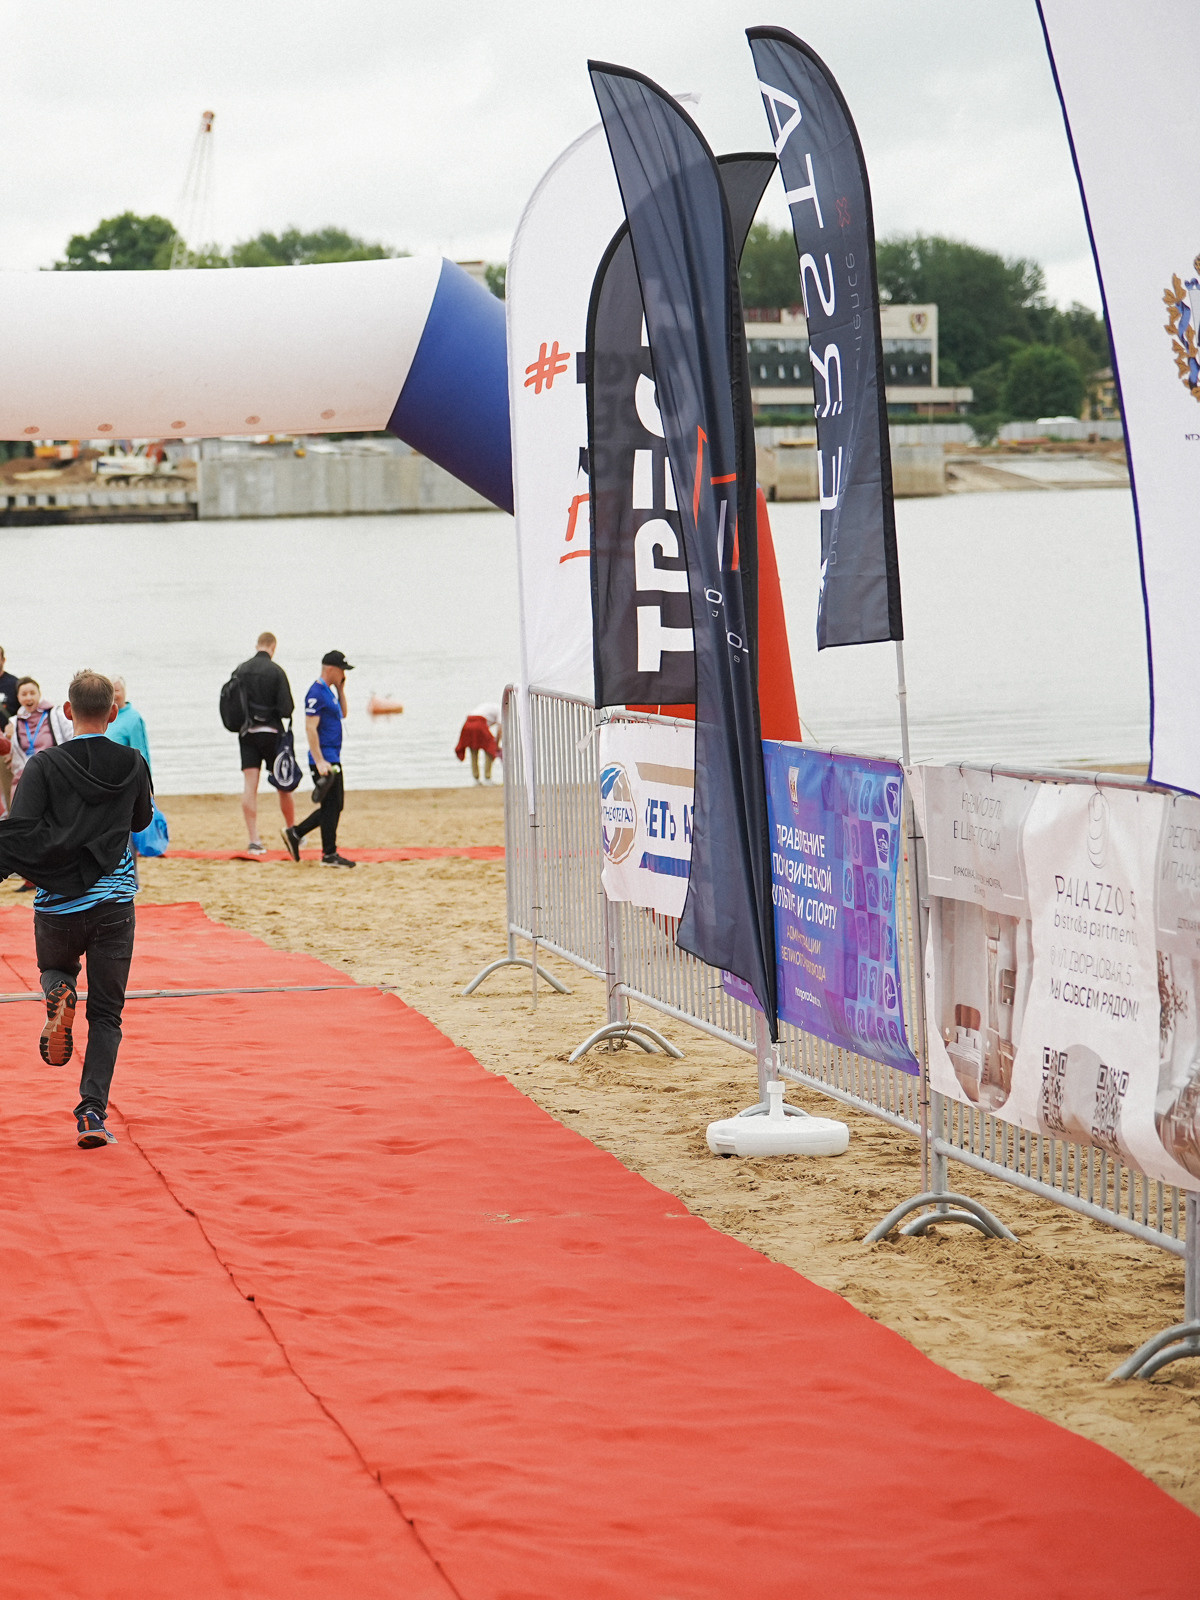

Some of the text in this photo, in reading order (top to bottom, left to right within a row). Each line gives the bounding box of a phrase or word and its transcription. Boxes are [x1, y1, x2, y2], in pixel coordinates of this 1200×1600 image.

[1054, 874, 1126, 917] PALAZZO
[804, 897, 838, 931] СПОРТУ
[1100, 991, 1140, 1022] РЯДОМ!
